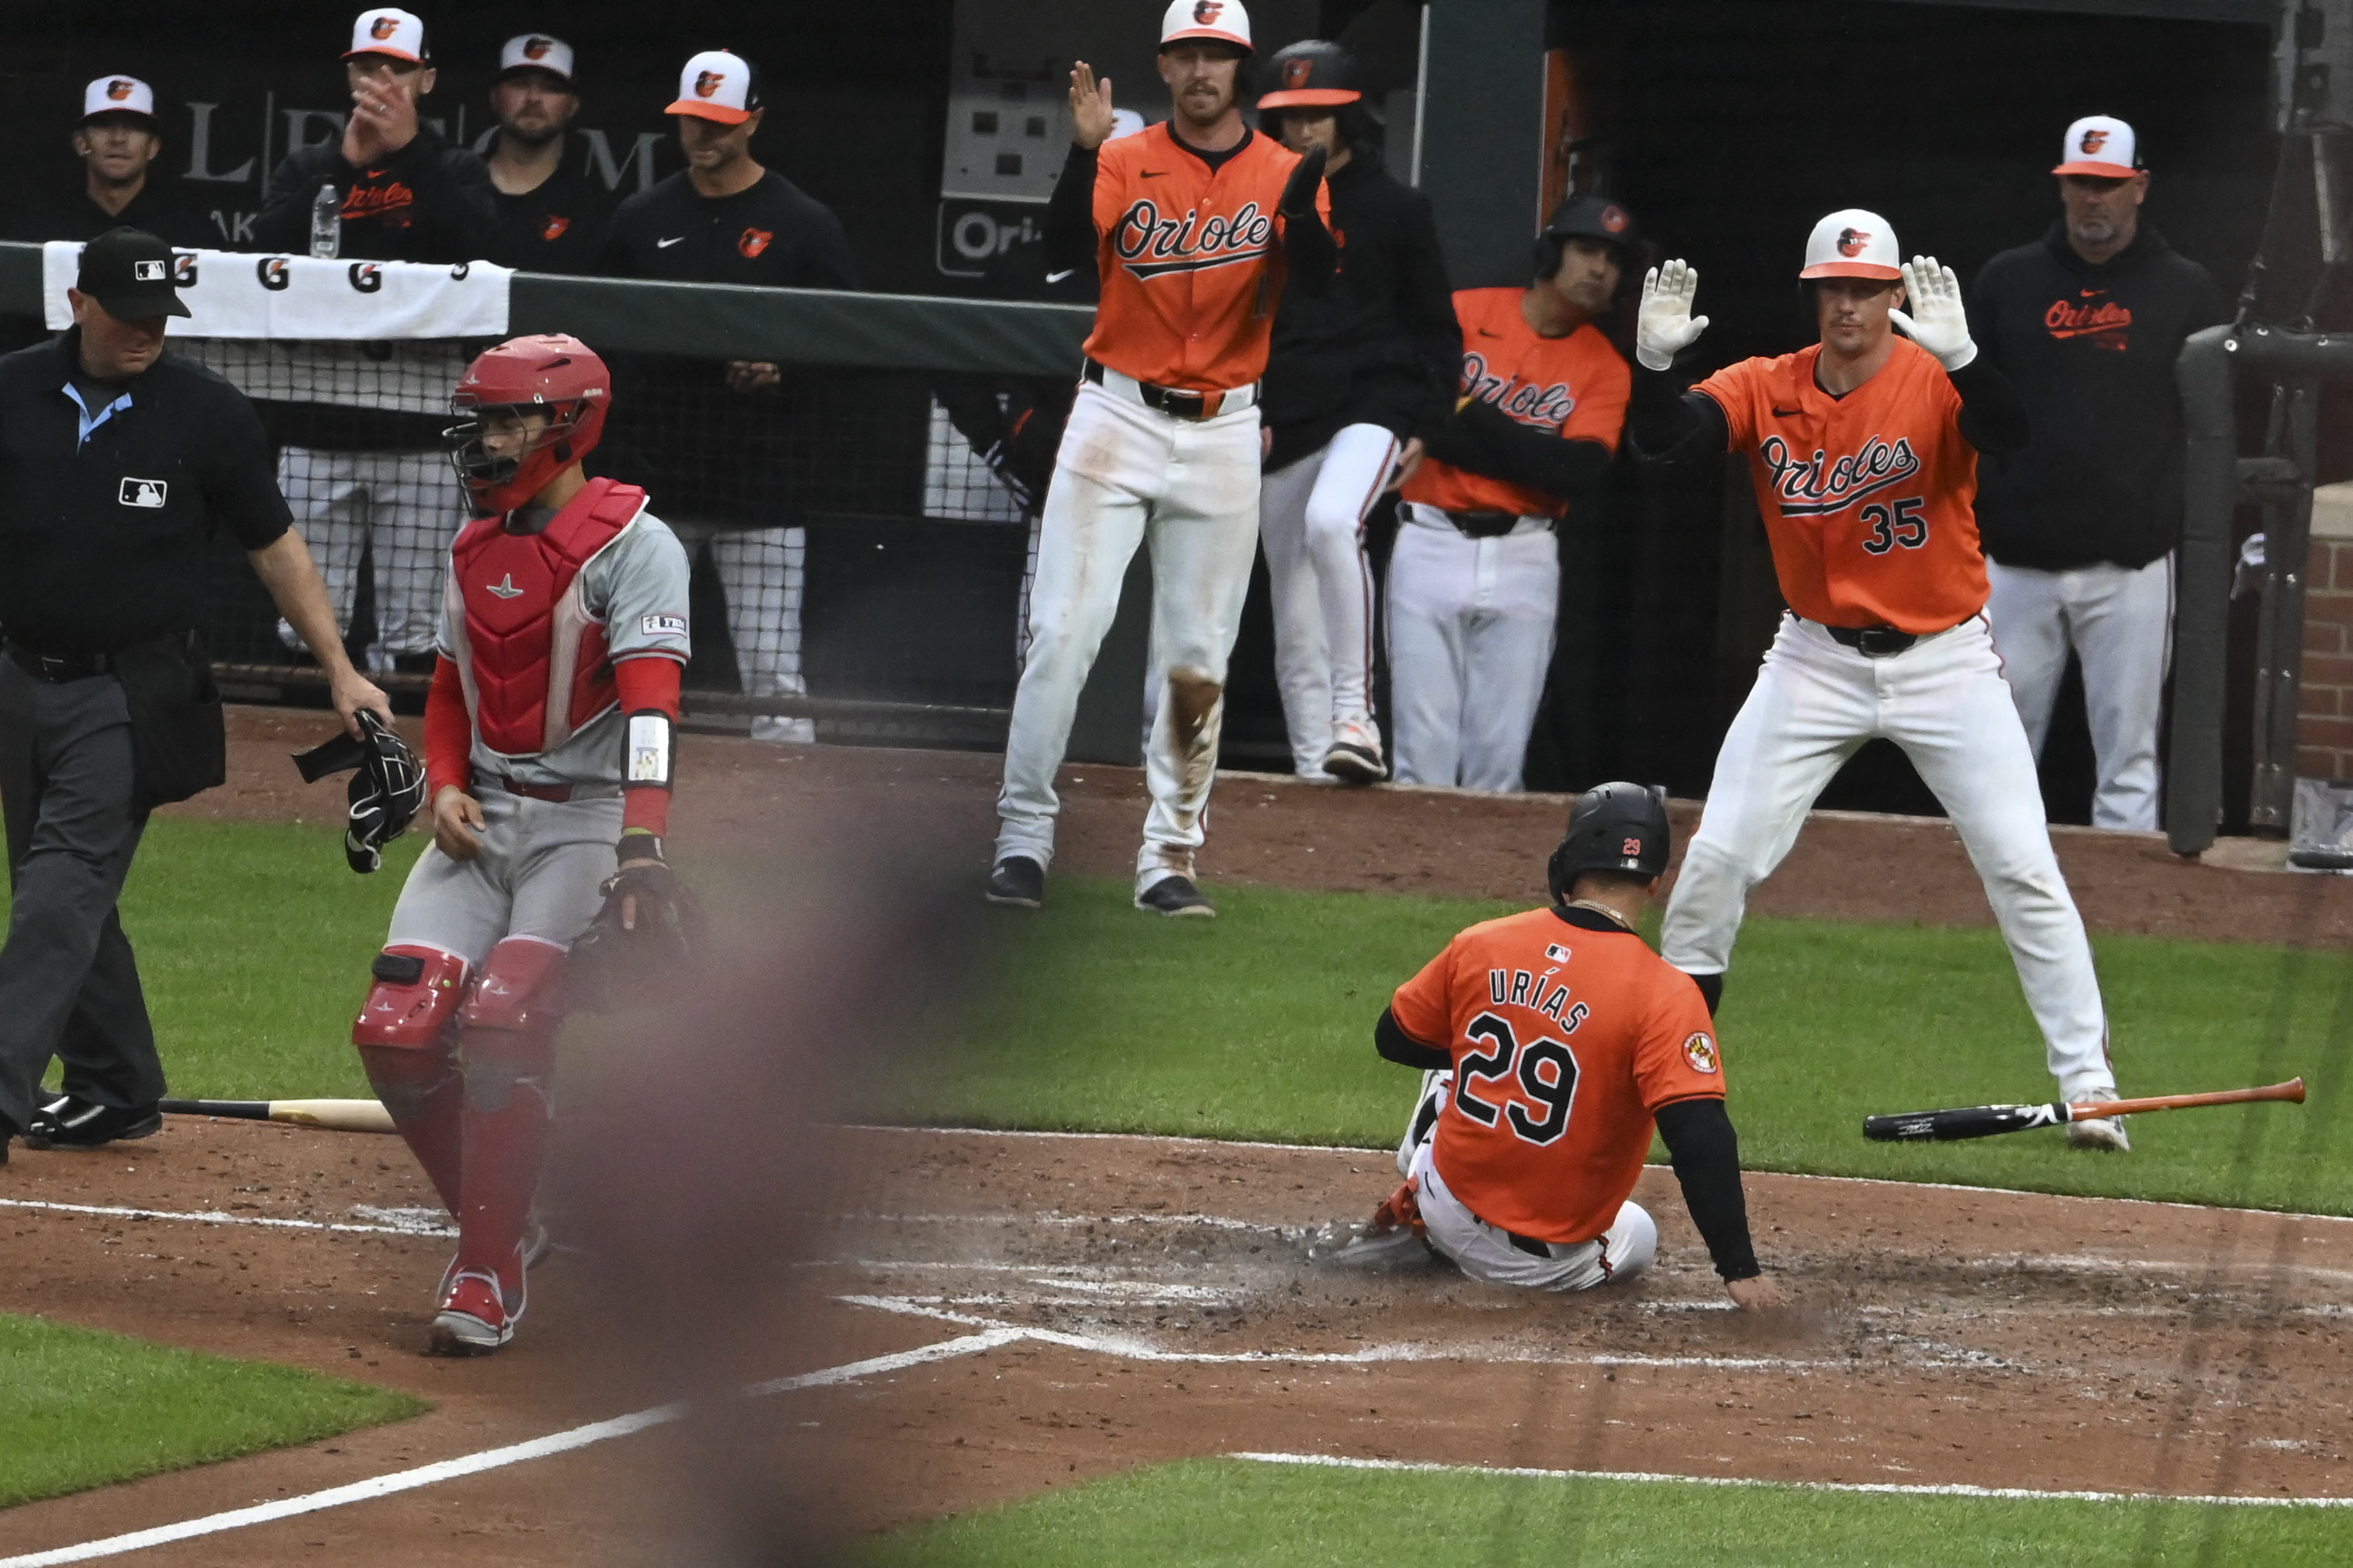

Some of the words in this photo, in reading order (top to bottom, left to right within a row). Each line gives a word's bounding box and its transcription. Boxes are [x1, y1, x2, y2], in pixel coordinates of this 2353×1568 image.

[953, 211, 1042, 259] Ori
[1114, 199, 1272, 259] Oriole
[258, 257, 289, 291] G
[349, 262, 382, 294] G
[1457, 351, 1576, 425] Oriole
[1760, 434, 1920, 501] Orioles
[1860, 496, 1930, 556] 35
[1623, 837, 1641, 856] 29
[1488, 966, 1590, 1035] URÍAS
[1455, 1010, 1582, 1148] 29
